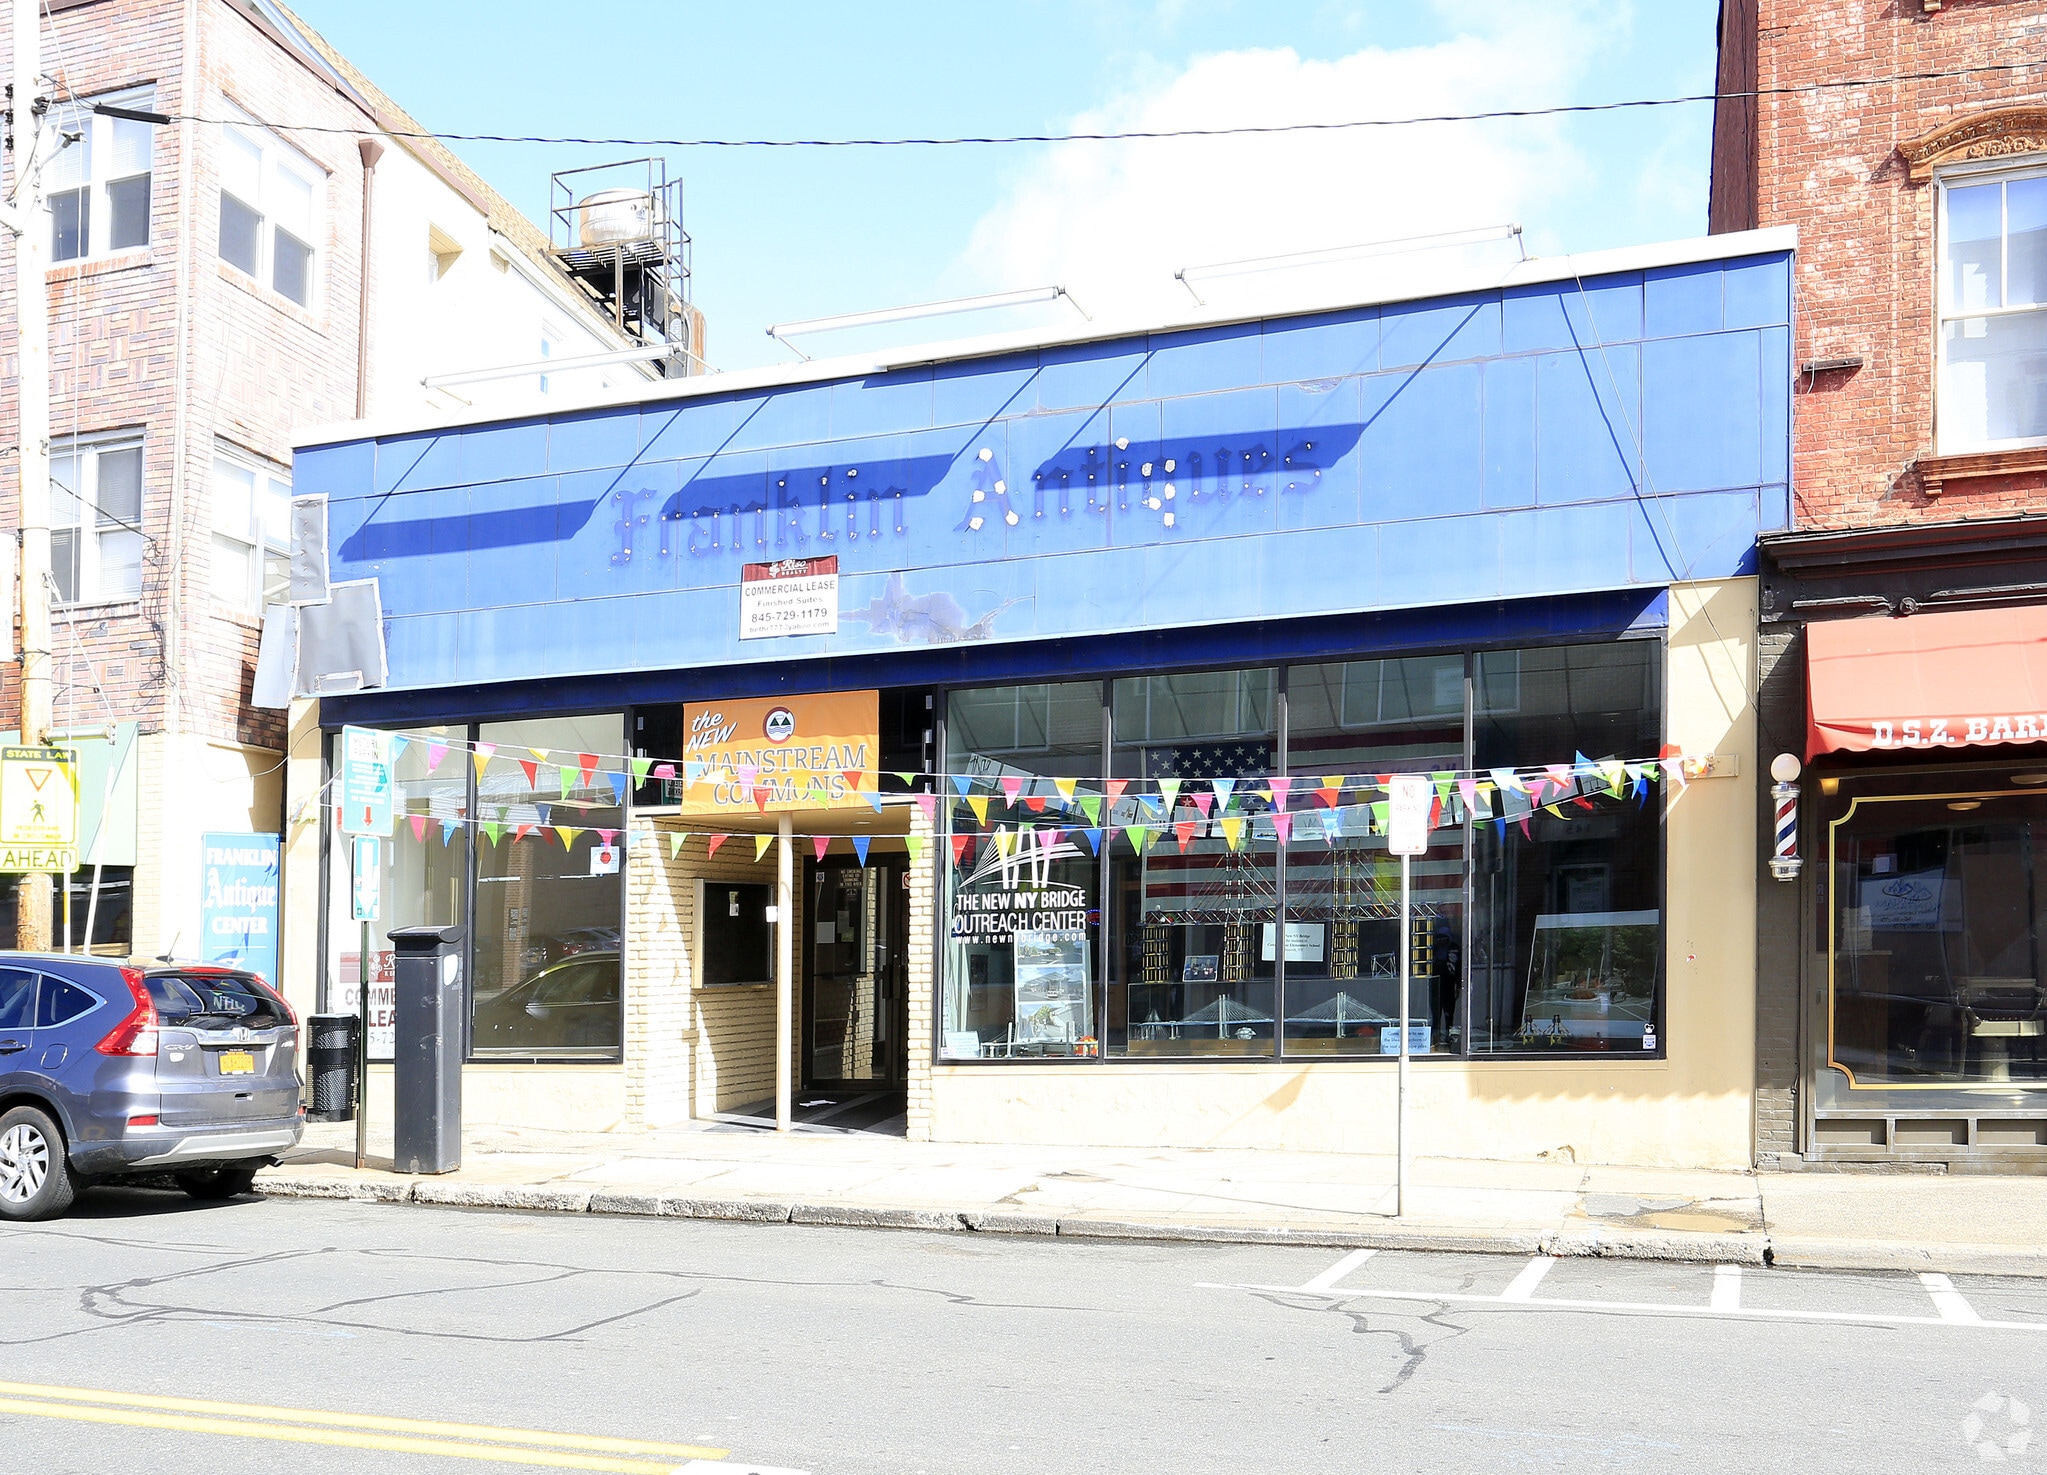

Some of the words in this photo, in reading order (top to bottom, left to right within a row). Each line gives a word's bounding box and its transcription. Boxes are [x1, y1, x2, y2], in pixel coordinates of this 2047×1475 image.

[610, 465, 909, 566] Franklin
[952, 436, 1324, 533] Antiques
[781, 559, 806, 570] Riso
[744, 583, 804, 597] COMMERCIAL
[806, 580, 835, 592] LEASE
[757, 598, 793, 607] Finished
[796, 596, 823, 604] Suites
[751, 607, 828, 623] 845-729-1179
[691, 710, 725, 733] the
[685, 721, 738, 753] NEW
[1871, 718, 1955, 747] D.S.Z.
[6, 749, 42, 759] STATE
[695, 743, 867, 779] MAINSTREAM
[1402, 784, 1416, 799] NO
[3, 850, 72, 867] AHEAD
[206, 847, 278, 867] FRANKLIN
[204, 866, 276, 914] Antique
[956, 893, 979, 911] THE
[981, 892, 1011, 910] NEW
[1014, 891, 1038, 909] NY
[1040, 889, 1086, 908] BRIDGE
[211, 916, 269, 935] CENTER
[954, 913, 1028, 934] OUTREACH
[1032, 910, 1086, 931] CENTER
[345, 987, 396, 1006] COMME
[368, 1010, 396, 1028] LEA
